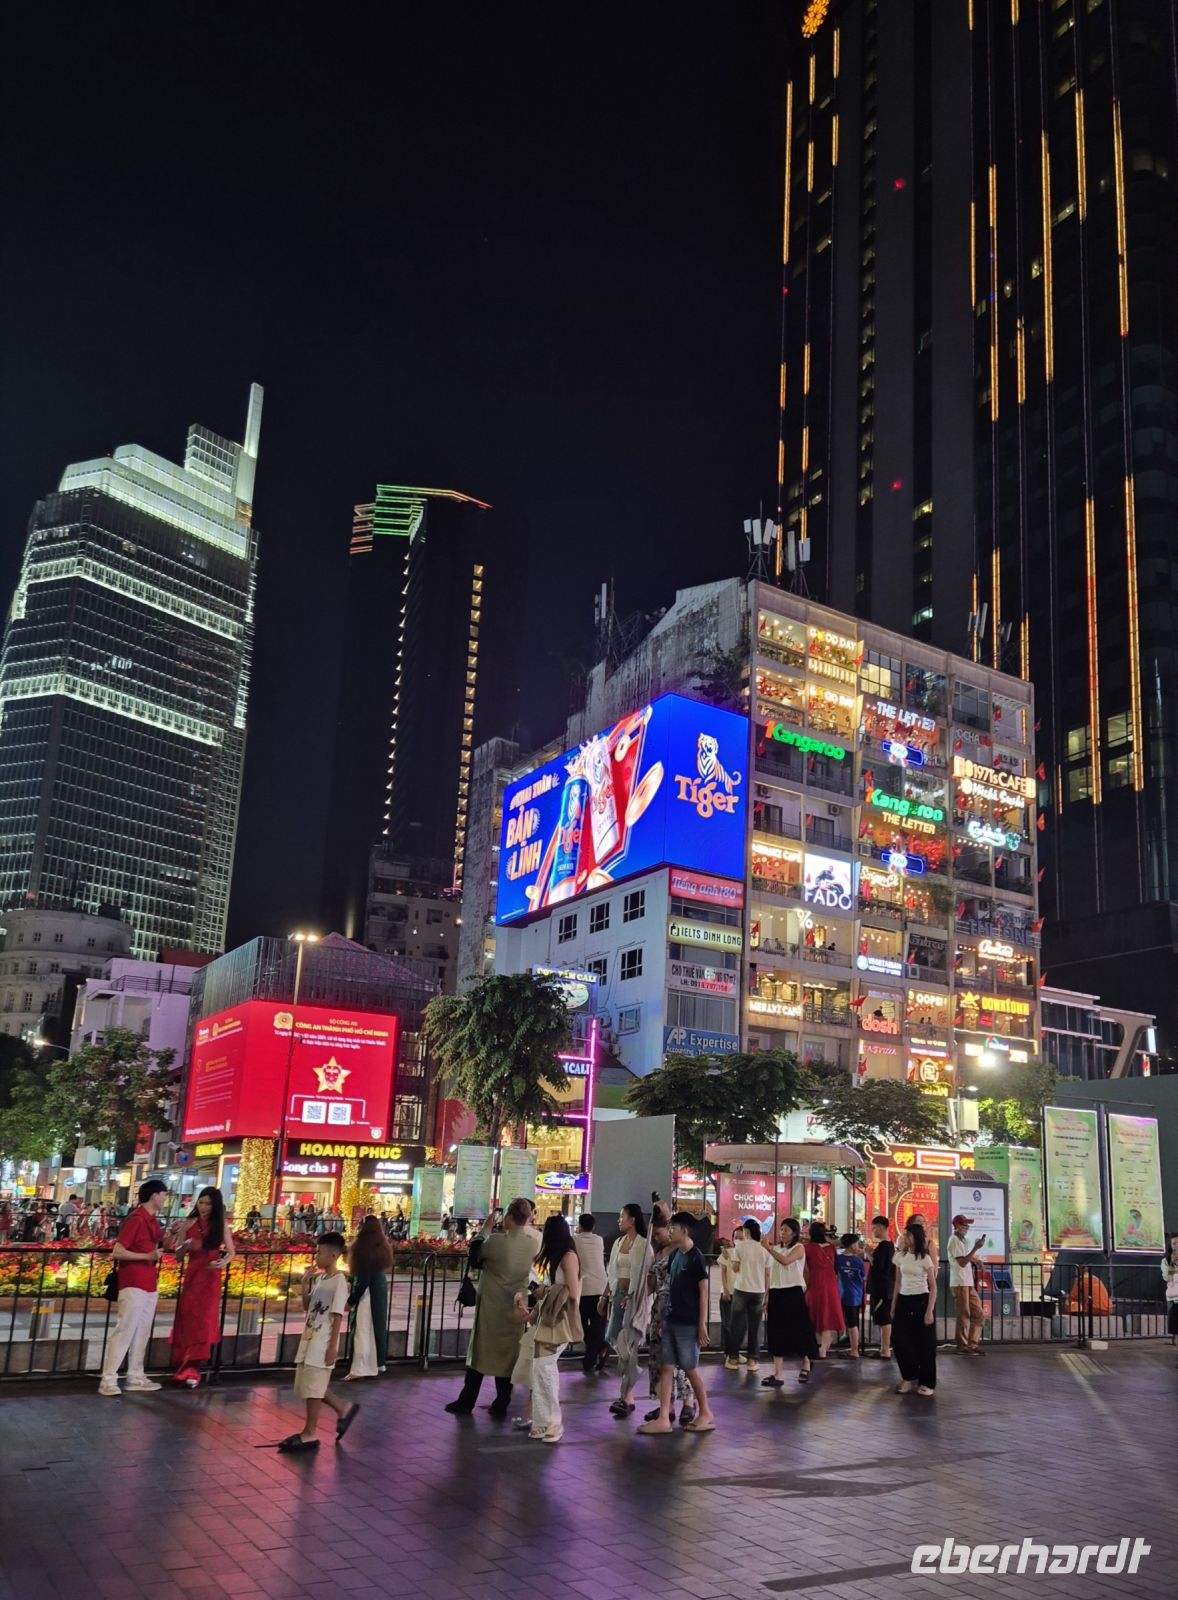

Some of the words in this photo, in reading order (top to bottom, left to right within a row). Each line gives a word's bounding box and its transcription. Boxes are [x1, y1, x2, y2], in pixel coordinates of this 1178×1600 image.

[838, 638, 857, 652] DAY
[877, 701, 897, 719] THE
[765, 720, 845, 760] Kangaroo
[674, 775, 738, 818] Tiger
[882, 811, 901, 825] THE
[901, 817, 936, 835] LETTER
[672, 875, 697, 896] Tiếng
[699, 884, 719, 897] anh
[805, 887, 852, 910] FADO
[681, 927, 701, 939] IELTS
[723, 934, 741, 945] LONG
[577, 974, 597, 983] CALI
[682, 965, 695, 978] THUÊ
[861, 1013, 898, 1035] dosh
[690, 1033, 738, 1050] Expertise
[569, 1062, 590, 1075] CALI
[300, 1143, 357, 1158] HOANG
[359, 1146, 402, 1160] PHUC
[309, 1162, 329, 1172] cha
[733, 1191, 754, 1201] CHÚC
[738, 1201, 755, 1210] NĂM
